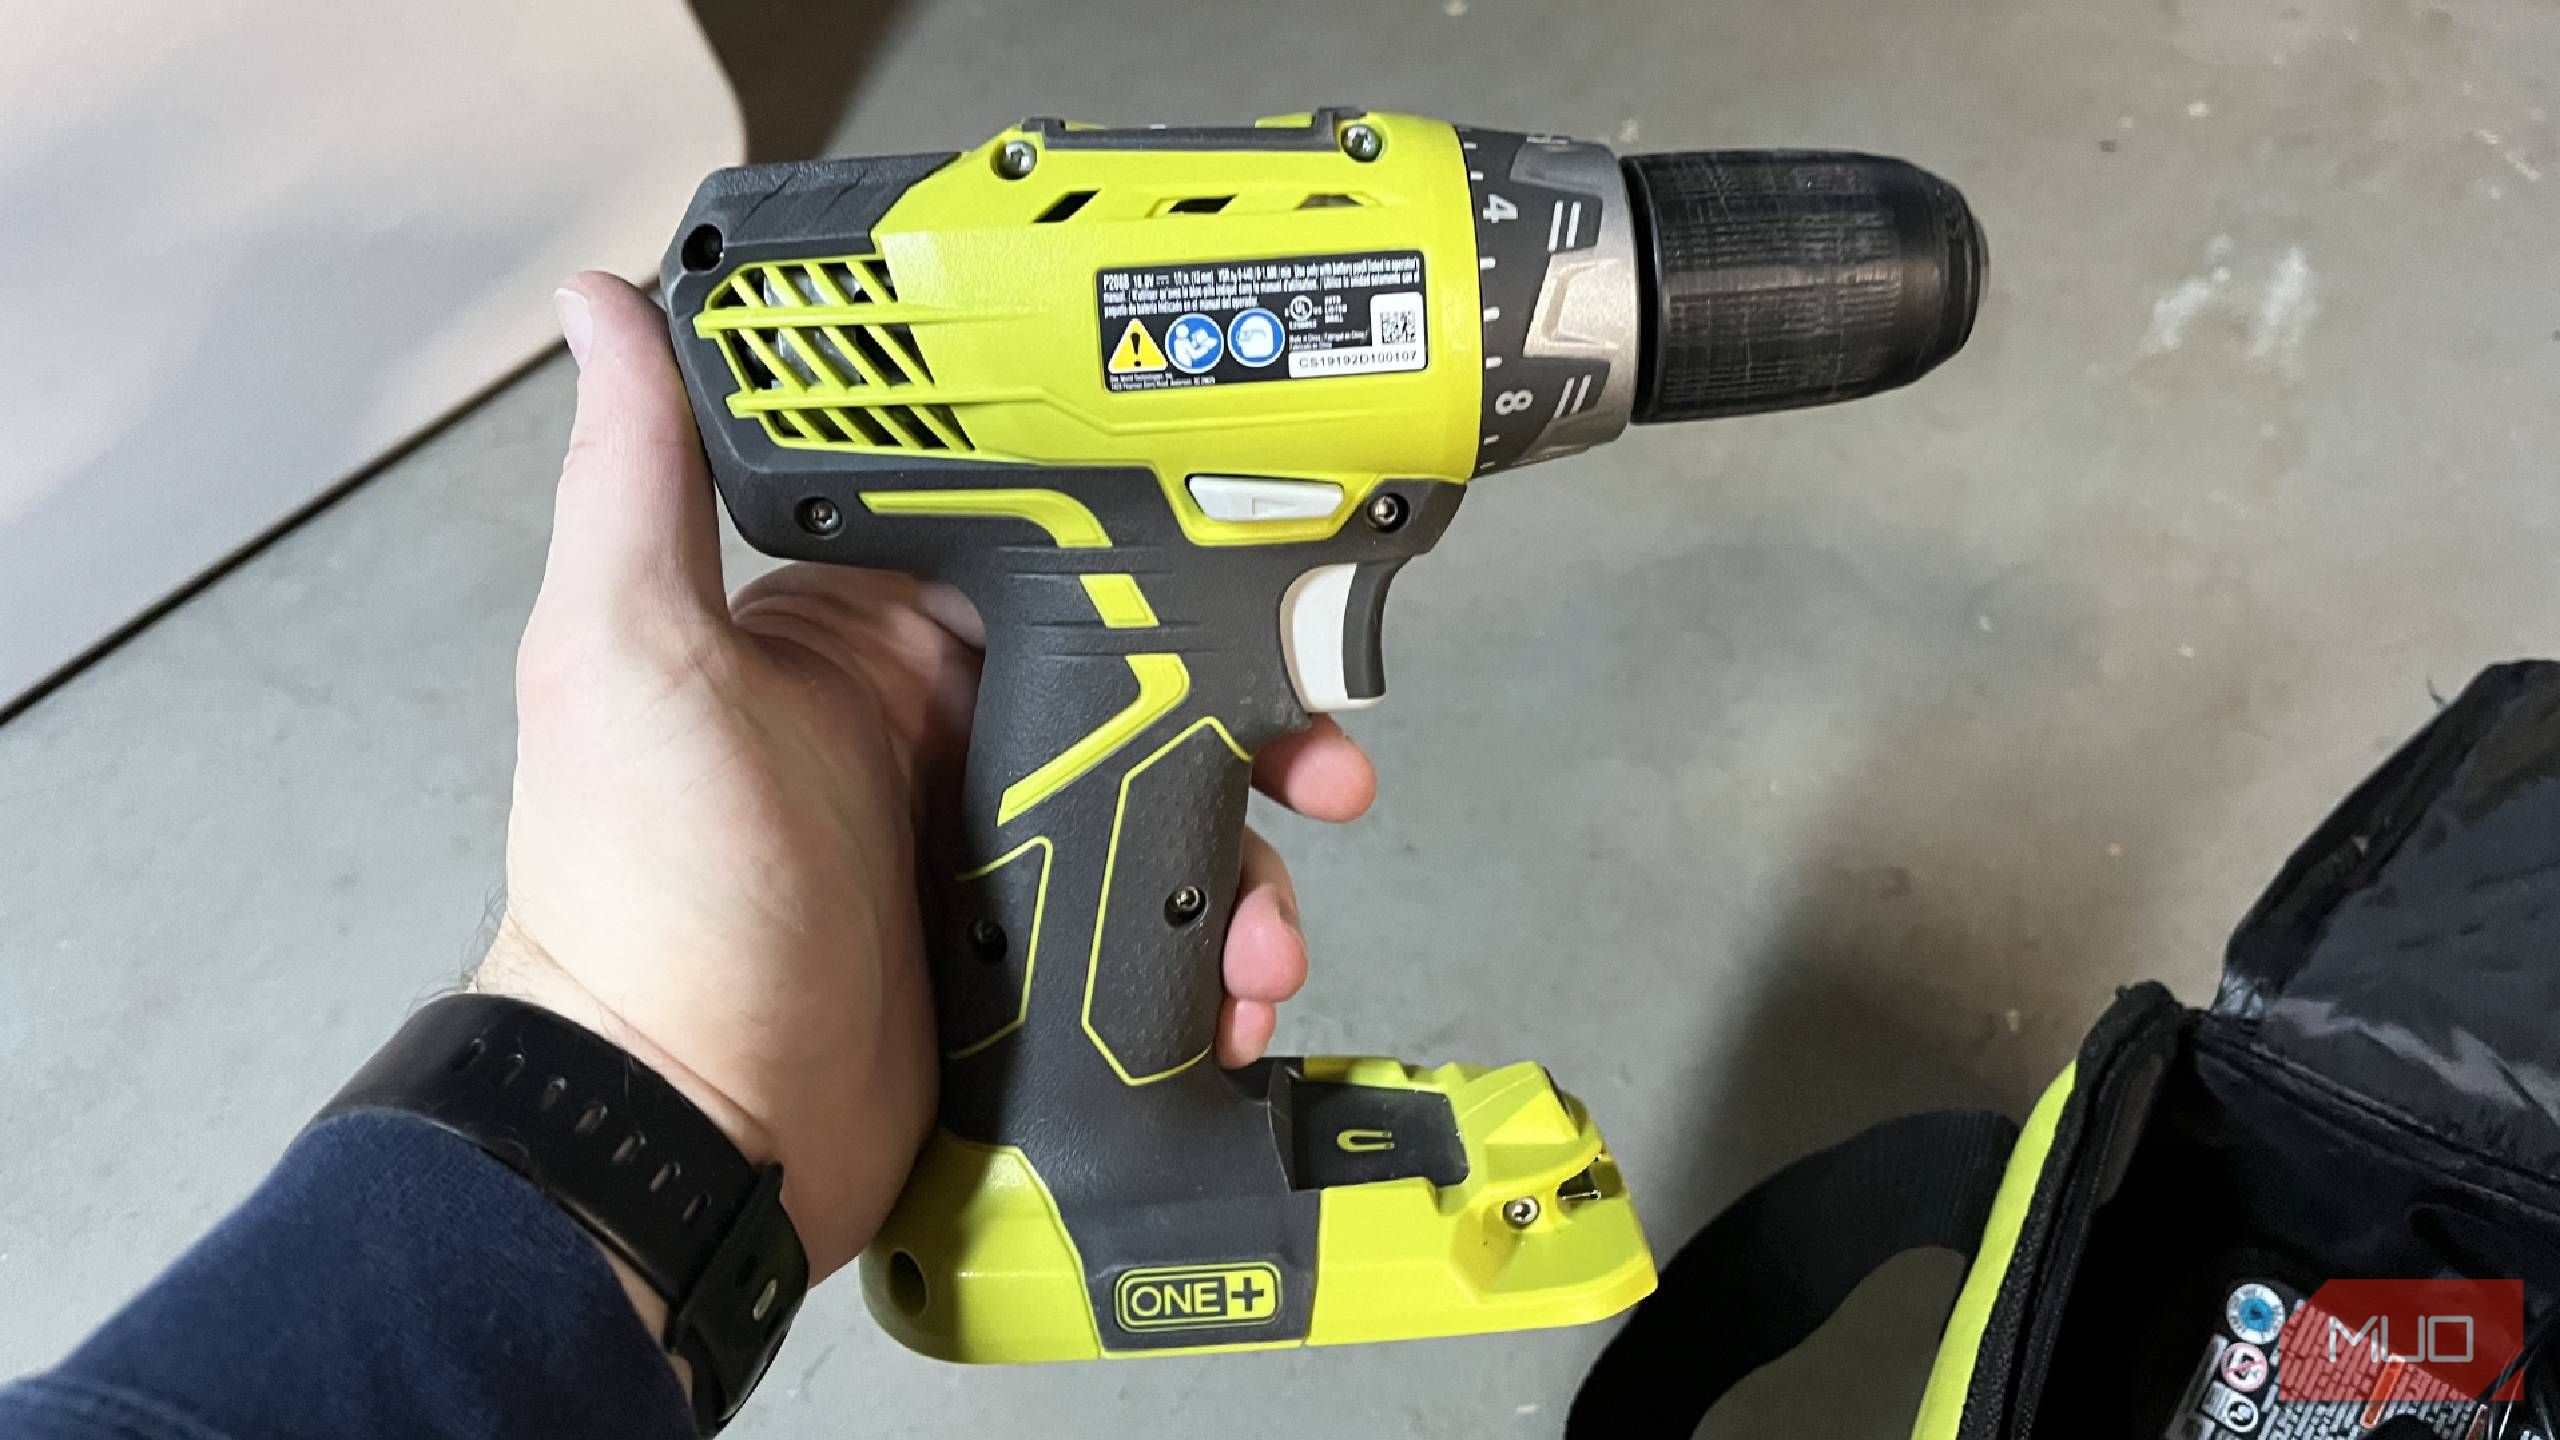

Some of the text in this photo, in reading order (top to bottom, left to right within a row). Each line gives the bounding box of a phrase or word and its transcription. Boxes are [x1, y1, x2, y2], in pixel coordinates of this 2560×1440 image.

[1482, 193, 1519, 223] 4
[1495, 389, 1534, 416] 8
[1130, 1277, 1264, 1317] ONE+
